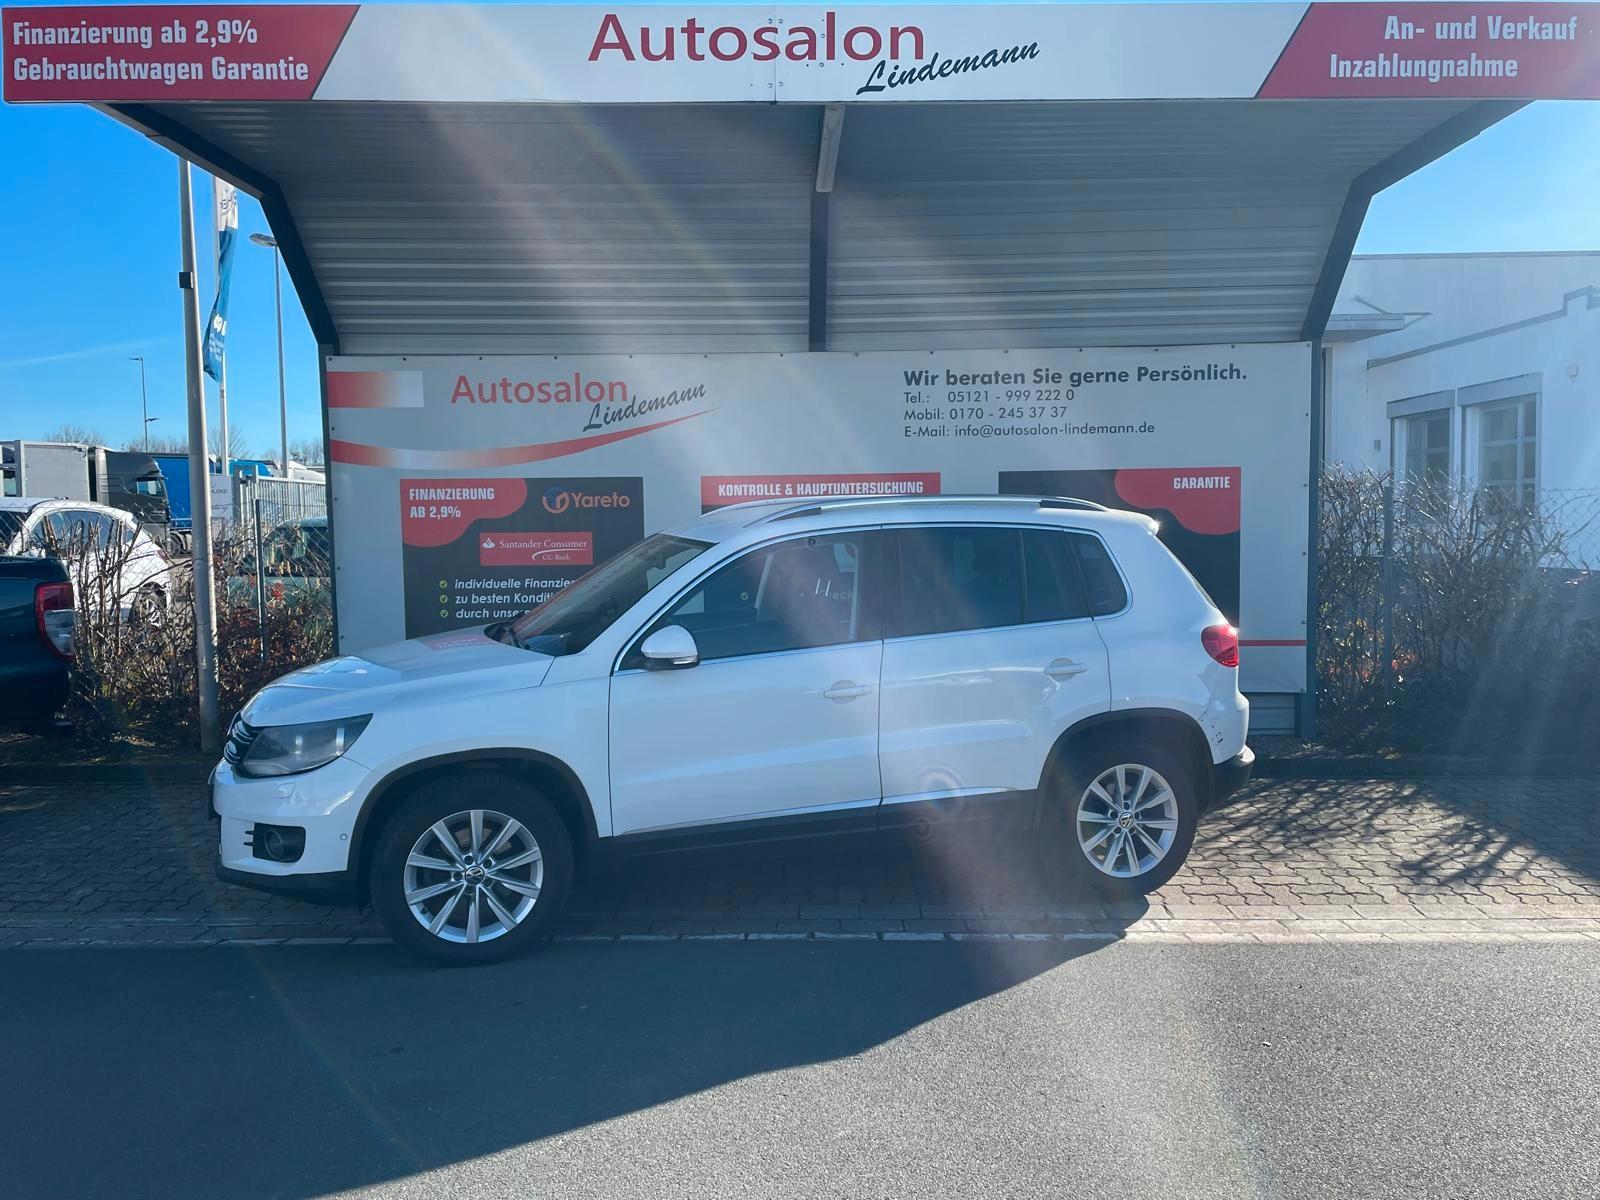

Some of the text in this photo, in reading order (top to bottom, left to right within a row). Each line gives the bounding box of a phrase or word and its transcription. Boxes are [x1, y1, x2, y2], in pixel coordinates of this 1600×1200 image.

[13, 19, 258, 49] Finanzierung ab 2,9%
[1384, 16, 1578, 40] An- und Verkauf
[588, 12, 924, 62] Autosalon
[13, 56, 309, 85] Gebrauchtwagen Garantie
[856, 41, 1040, 95] Lindemann
[1330, 53, 1519, 83] Inzahlungnahme
[904, 363, 1247, 387] Wir beraten Sie gerne Persönlich.
[450, 372, 628, 405] Autosalon
[904, 391, 930, 403] Tel.:
[947, 390, 989, 403] 05121
[1005, 390, 1031, 401] 999
[1035, 389, 1061, 401] 222
[1066, 389, 1075, 401] 0
[583, 383, 706, 432] Lindemann
[904, 408, 945, 421] Mobil:
[950, 407, 984, 419] 0170
[998, 407, 1024, 419] 245
[1028, 406, 1046, 419] 37
[1050, 406, 1068, 418] 37
[904, 422, 1155, 438] E-Mail: info@autosalon-lindemann.de
[718, 481, 924, 497] KONTROLLE & HAUPTUNTERSUCHUNG
[1173, 476, 1231, 490] GARANTIE
[409, 487, 495, 501] FINANZIERUNG
[570, 491, 631, 508] Yareto
[410, 505, 461, 520] AB 2,9%
[499, 539, 587, 549] Santander Consumer
[455, 578, 521, 589] individuelle
[455, 595, 468, 604] zu
[472, 594, 511, 604] besten
[456, 609, 489, 619] durch
